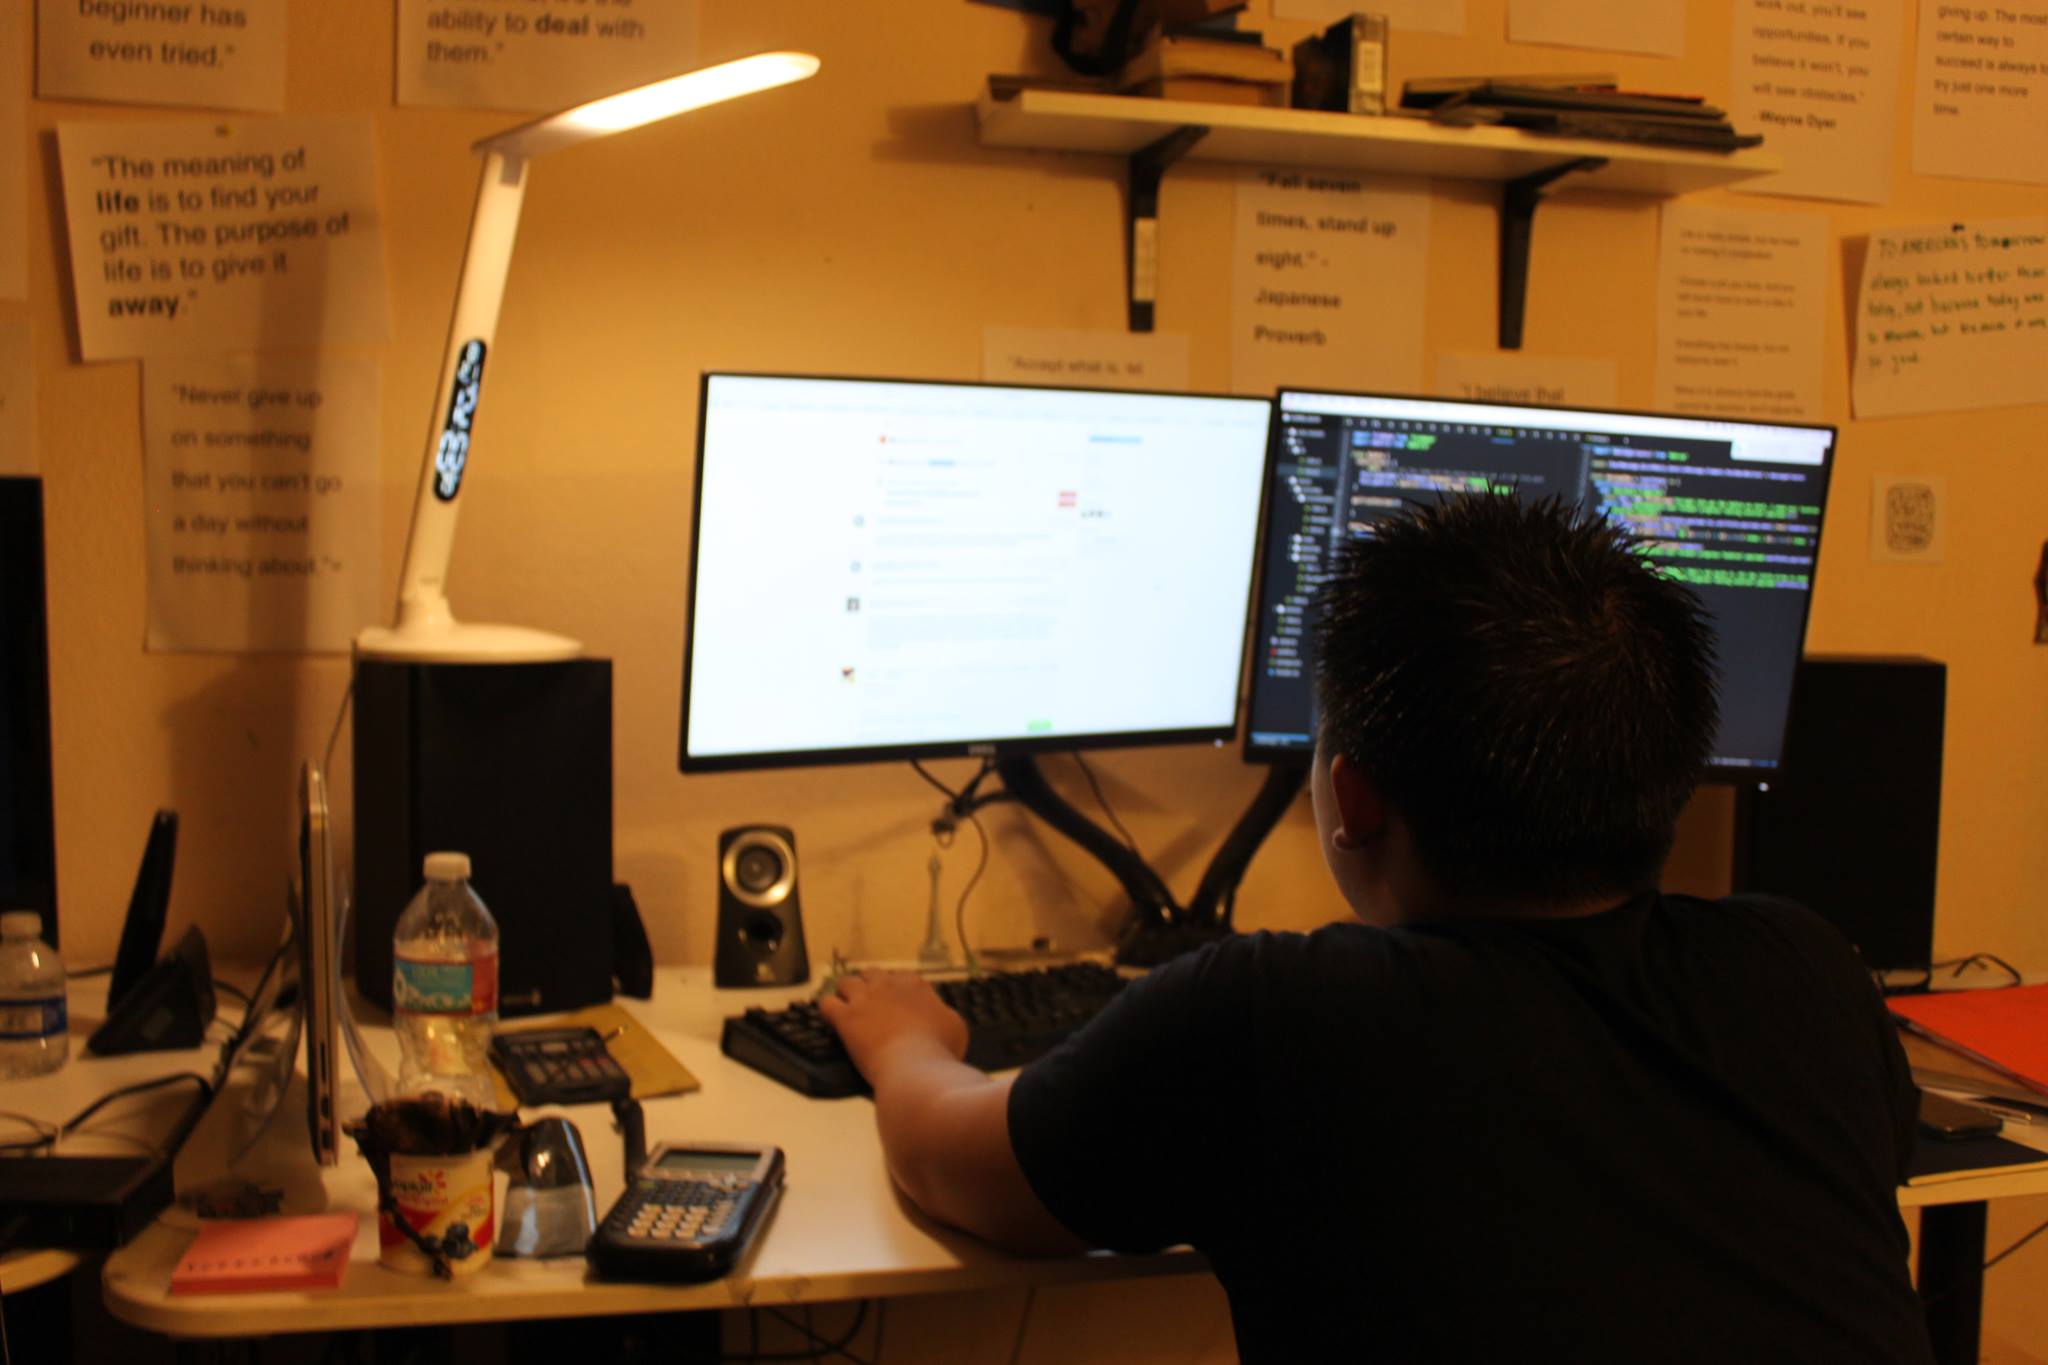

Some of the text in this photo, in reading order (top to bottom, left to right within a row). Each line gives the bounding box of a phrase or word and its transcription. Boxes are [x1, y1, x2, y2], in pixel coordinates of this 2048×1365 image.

[80, 0, 247, 27] beginner has
[427, 9, 646, 39] ability to deal with
[1976, 35, 2000, 49] way
[2002, 34, 2015, 48] to
[90, 40, 236, 68] even tried."
[1935, 56, 1983, 72] succeed
[1998, 61, 2038, 77] always
[1974, 84, 1996, 96] one
[1998, 85, 2029, 99] more
[1760, 109, 1804, 128] Wayne
[1806, 112, 1836, 130] Dyer
[91, 146, 306, 179] "The meaning of
[1306, 176, 1362, 192] seven
[97, 184, 319, 214] life is to find your
[100, 211, 350, 253] gift. The purpose of
[1317, 216, 1368, 233] stand
[1372, 220, 1397, 238] up
[103, 251, 288, 284] life is to give it
[1254, 286, 1342, 307] Japanese
[1253, 325, 1327, 346] Proverb
[1067, 358, 1099, 373] what
[247, 387, 291, 410] give
[296, 391, 323, 409] up
[1536, 383, 1567, 401] that
[171, 430, 311, 453] on something
[171, 471, 211, 490] that
[217, 476, 257, 494] you
[315, 476, 343, 495] go
[191, 514, 229, 535] day
[234, 514, 310, 534] without
[171, 555, 251, 578] thinking
